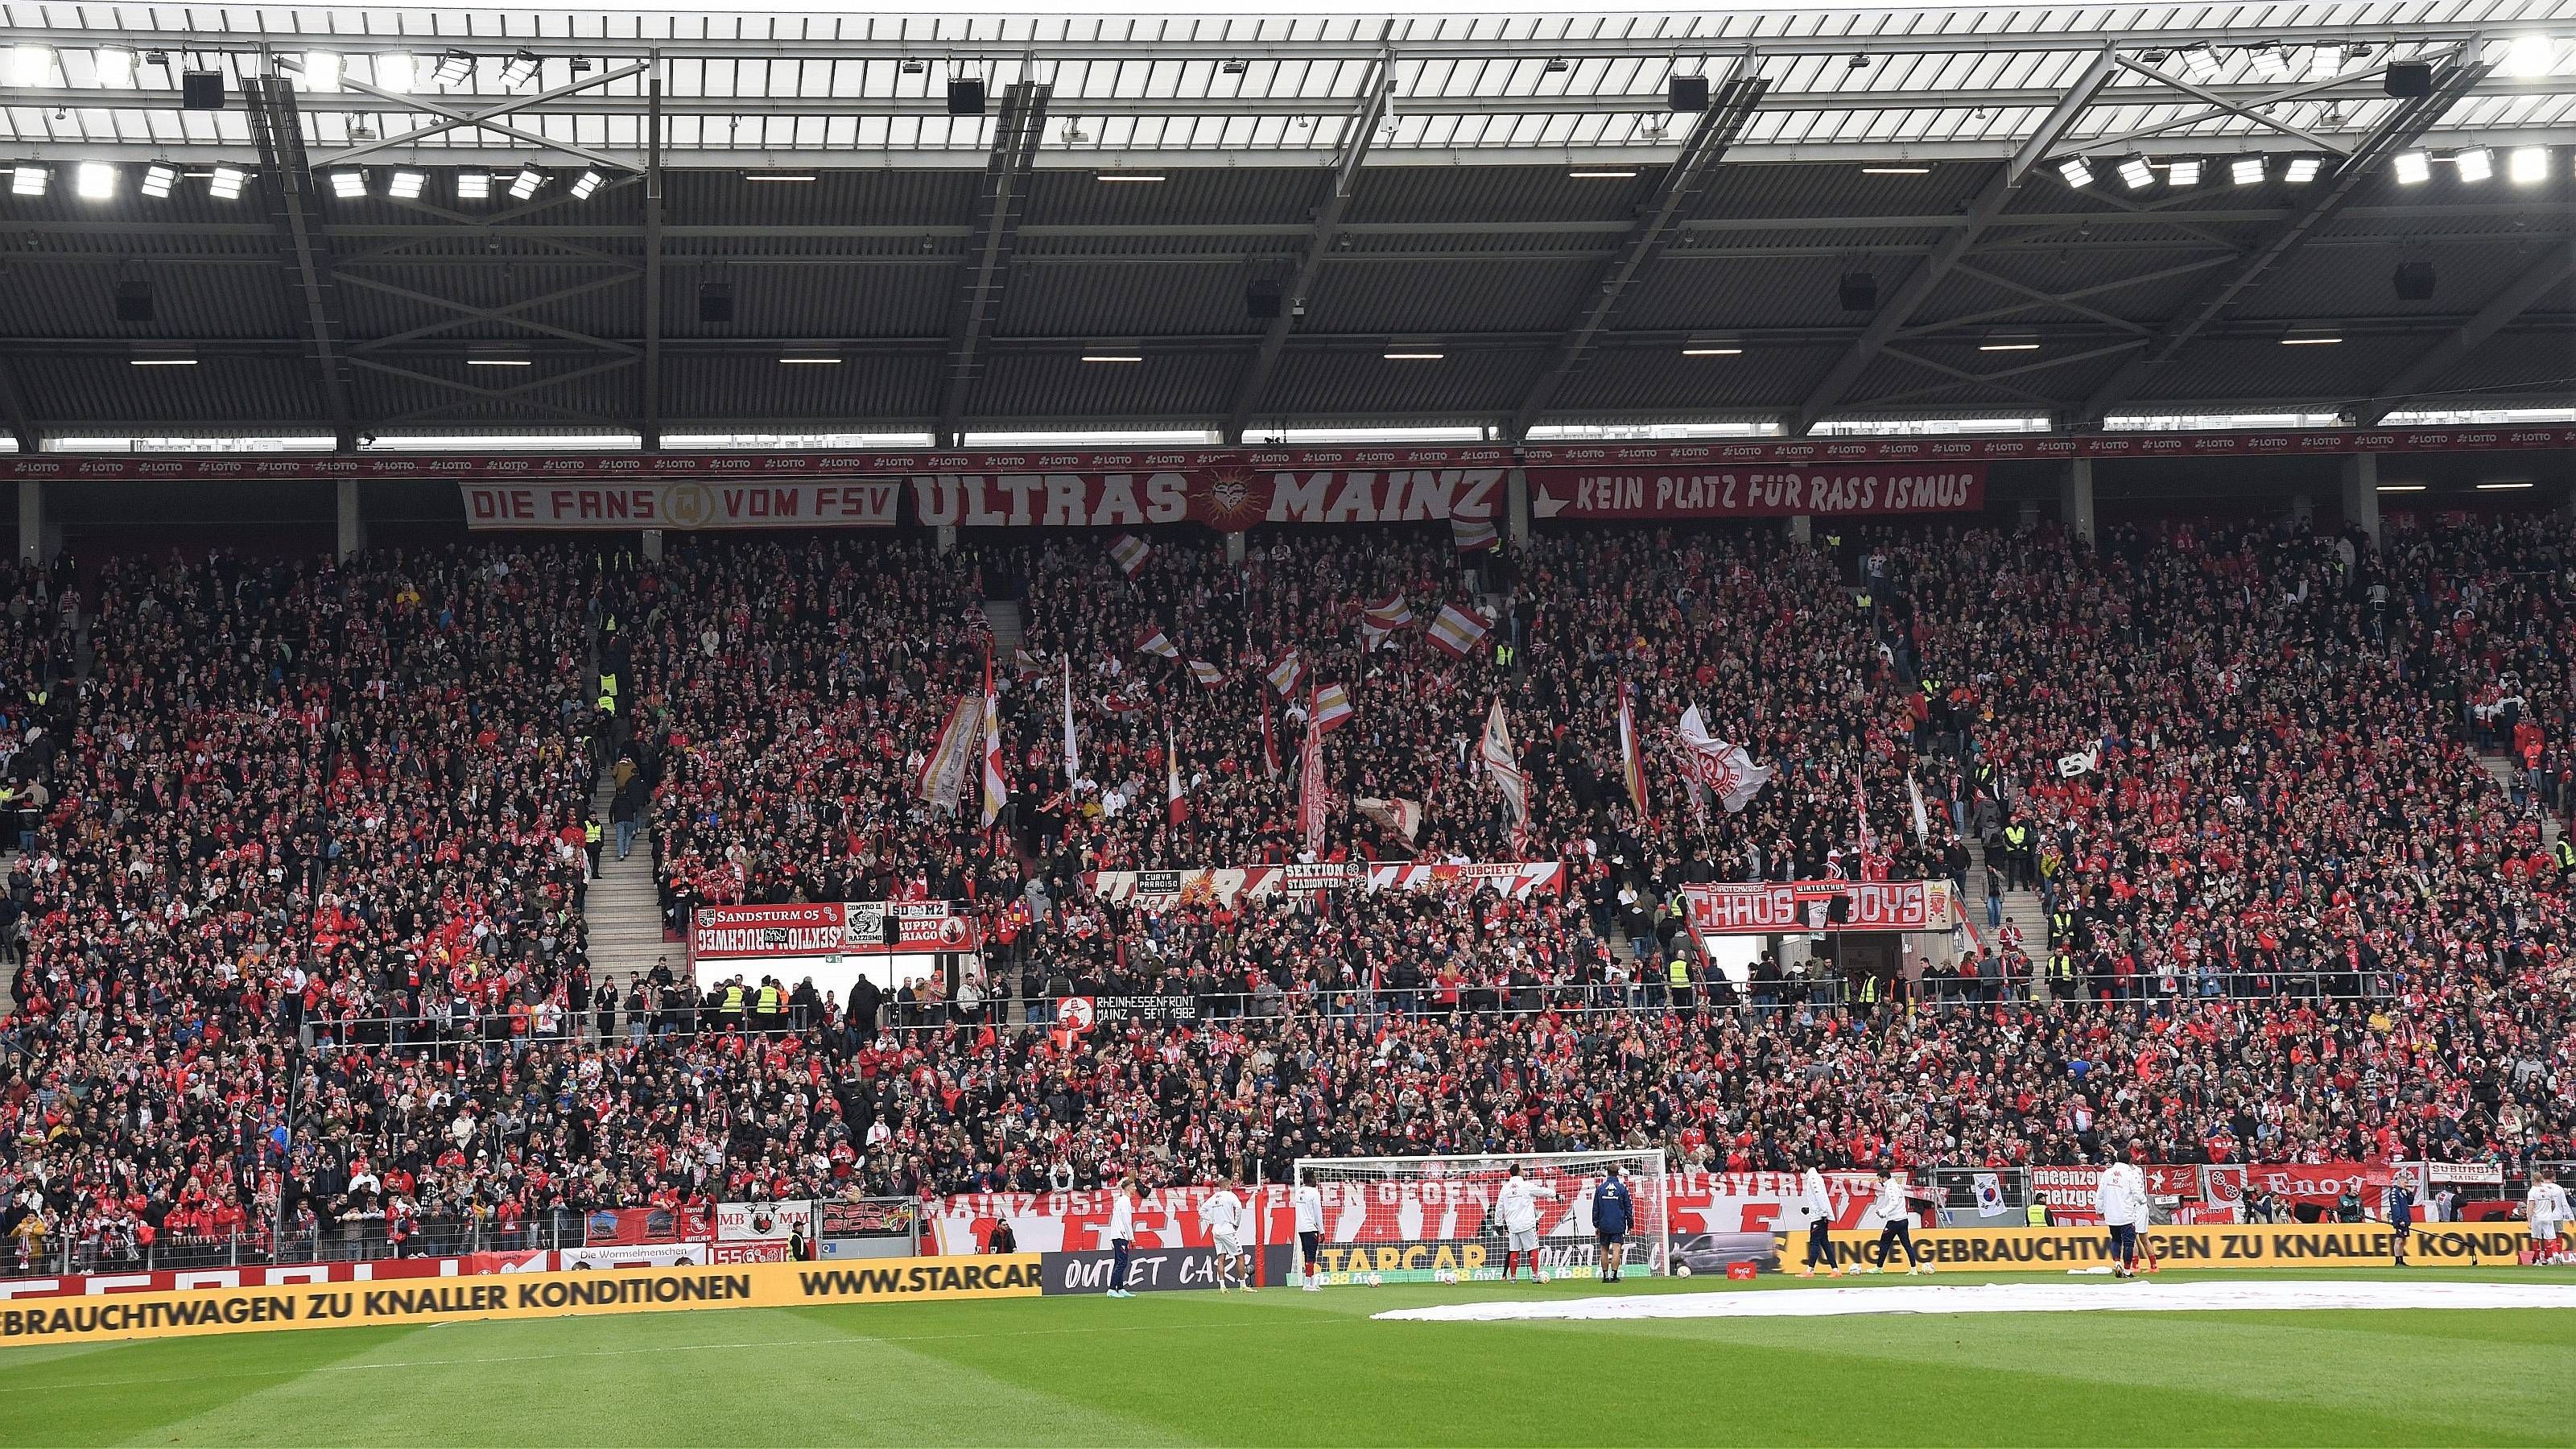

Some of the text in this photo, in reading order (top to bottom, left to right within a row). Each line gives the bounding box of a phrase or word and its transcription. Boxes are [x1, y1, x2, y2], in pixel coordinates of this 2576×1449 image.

[2313, 436, 2341, 445] LOTTO
[2366, 436, 2394, 444] LOTTO
[2420, 435, 2448, 444] LOTTO
[2468, 433, 2497, 442] LOTTO
[2522, 432, 2551, 441] LOTTO
[2101, 440, 2129, 449] LOTTO
[2153, 440, 2182, 448] LOTTO
[2207, 439, 2235, 448] LOTTO
[2260, 438, 2288, 447] LOTTO
[1682, 448, 1709, 456] LOTTO
[1734, 447, 1761, 456] LOTTO
[1786, 446, 1814, 455] LOTTO
[1839, 445, 1866, 454] LOTTO
[1891, 444, 1919, 453] LOTTO
[1943, 444, 1971, 452] LOTTO
[1996, 443, 2024, 452] LOTTO
[1314, 452, 1343, 461] LOTTO
[1368, 452, 1394, 460] LOTTO
[1420, 452, 1447, 460] LOTTO
[1472, 451, 1500, 460] LOTTO
[1525, 450, 1552, 459] LOTTO
[1577, 449, 1605, 458] LOTTO
[1629, 448, 1657, 457] LOTTO
[886, 457, 914, 466] LOTTO
[940, 457, 968, 466] LOTTO
[997, 456, 1026, 465] LOTTO
[1051, 456, 1079, 464] LOTTO
[1104, 456, 1132, 464] LOTTO
[1157, 455, 1185, 464] LOTTO
[1261, 453, 1290, 462] LOTTO
[210, 461, 242, 472] LOTTO
[269, 461, 300, 471] LOTTO
[385, 460, 415, 470] LOTTO
[442, 460, 473, 470] LOTTO
[498, 460, 529, 470] LOTTO
[555, 460, 584, 469] LOTTO
[611, 460, 640, 469] LOTTO
[667, 460, 696, 469] LOTTO
[721, 459, 751, 469] LOTTO
[777, 459, 806, 468] LOTTO
[832, 458, 860, 467] LOTTO
[27, 462, 60, 473] LOTTO
[92, 462, 124, 473] LOTTO
[151, 462, 184, 473] LOTTO
[1576, 476, 1644, 510] KEIN
[1655, 475, 1736, 510] PLATZ
[1747, 473, 1802, 510] FÜR
[1885, 473, 1973, 507] ISMUS
[912, 469, 1505, 526] ULTRAS MAINZ
[472, 486, 891, 519] DIE FANS VOM FSV
[1286, 864, 1344, 877] SEKTION
[1460, 865, 1521, 875] SUBCIETY
[1795, 884, 1845, 892] WINTERTHUR
[1686, 889, 1794, 927] CHAOS
[803, 910, 819, 921] 05
[1096, 1007, 1195, 1021] MAINZ SEIT 1982
[2433, 1165, 2499, 1174] SUBURBIA
[824, 1203, 884, 1218] RED
[720, 1212, 810, 1226] MB MM
[824, 1217, 884, 1232] SIDE
[1913, 1235, 2210, 1262] GEBRAUCHTWGEN
[2222, 1234, 2263, 1258] ZU
[580, 1247, 687, 1259] Die Wormselmenschen
[0, 1263, 1042, 1336] BRAUCHTWAGEN ZU KNALLER KONDITIONEN WWW.STARCAR
